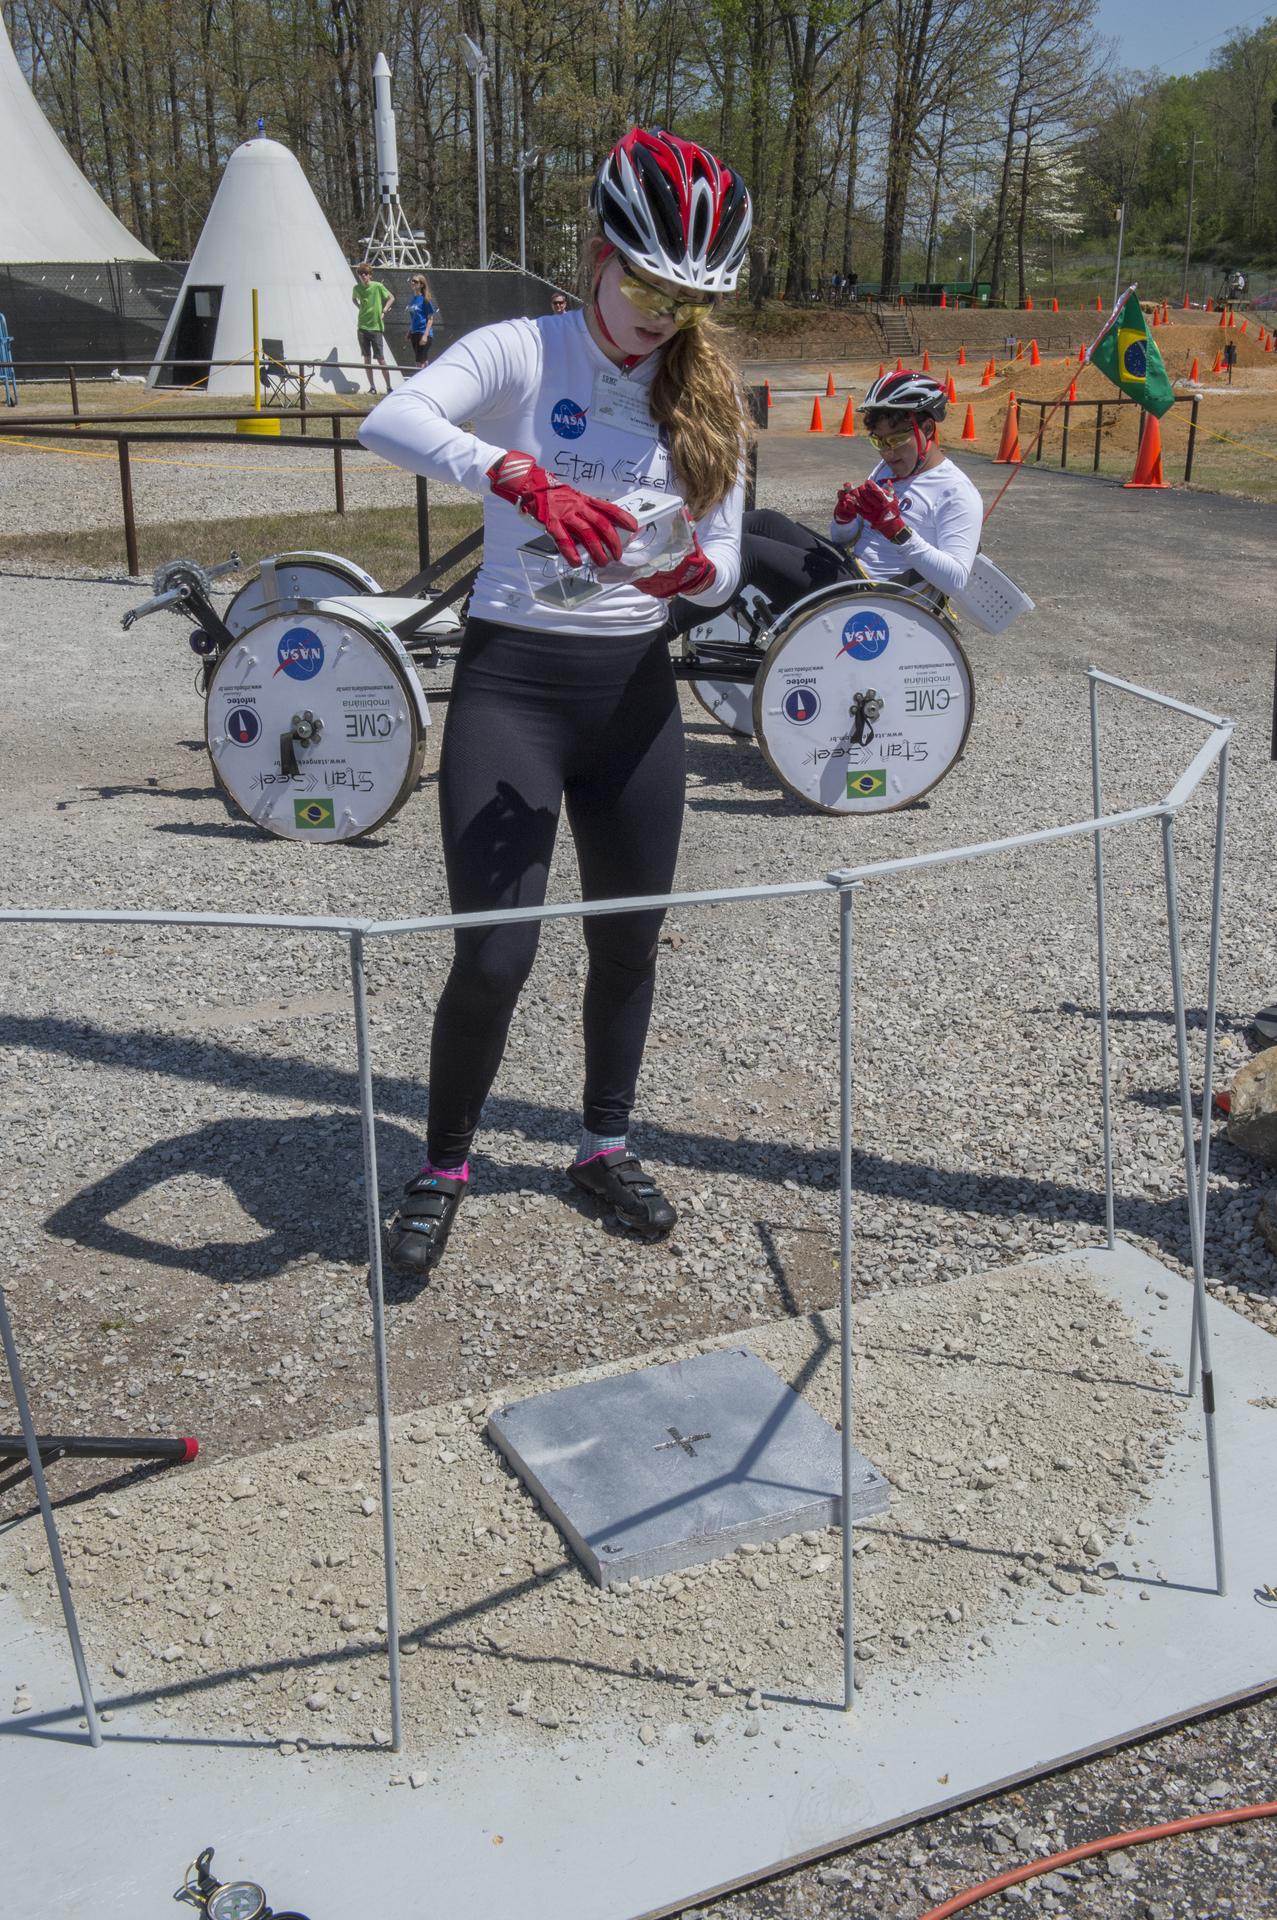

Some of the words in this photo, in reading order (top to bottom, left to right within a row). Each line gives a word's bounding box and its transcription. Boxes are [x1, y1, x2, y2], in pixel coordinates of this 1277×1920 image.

[553, 413, 584, 428] NASA
[554, 451, 605, 483] Stan
[845, 629, 886, 642] NASA
[280, 649, 321, 661] NASA
[786, 677, 817, 685] Infotec
[226, 697, 256, 705] Infotec
[904, 688, 951, 713] CME
[344, 713, 392, 738] CME
[880, 739, 928, 762] Stan
[324, 767, 375, 792] Stan
